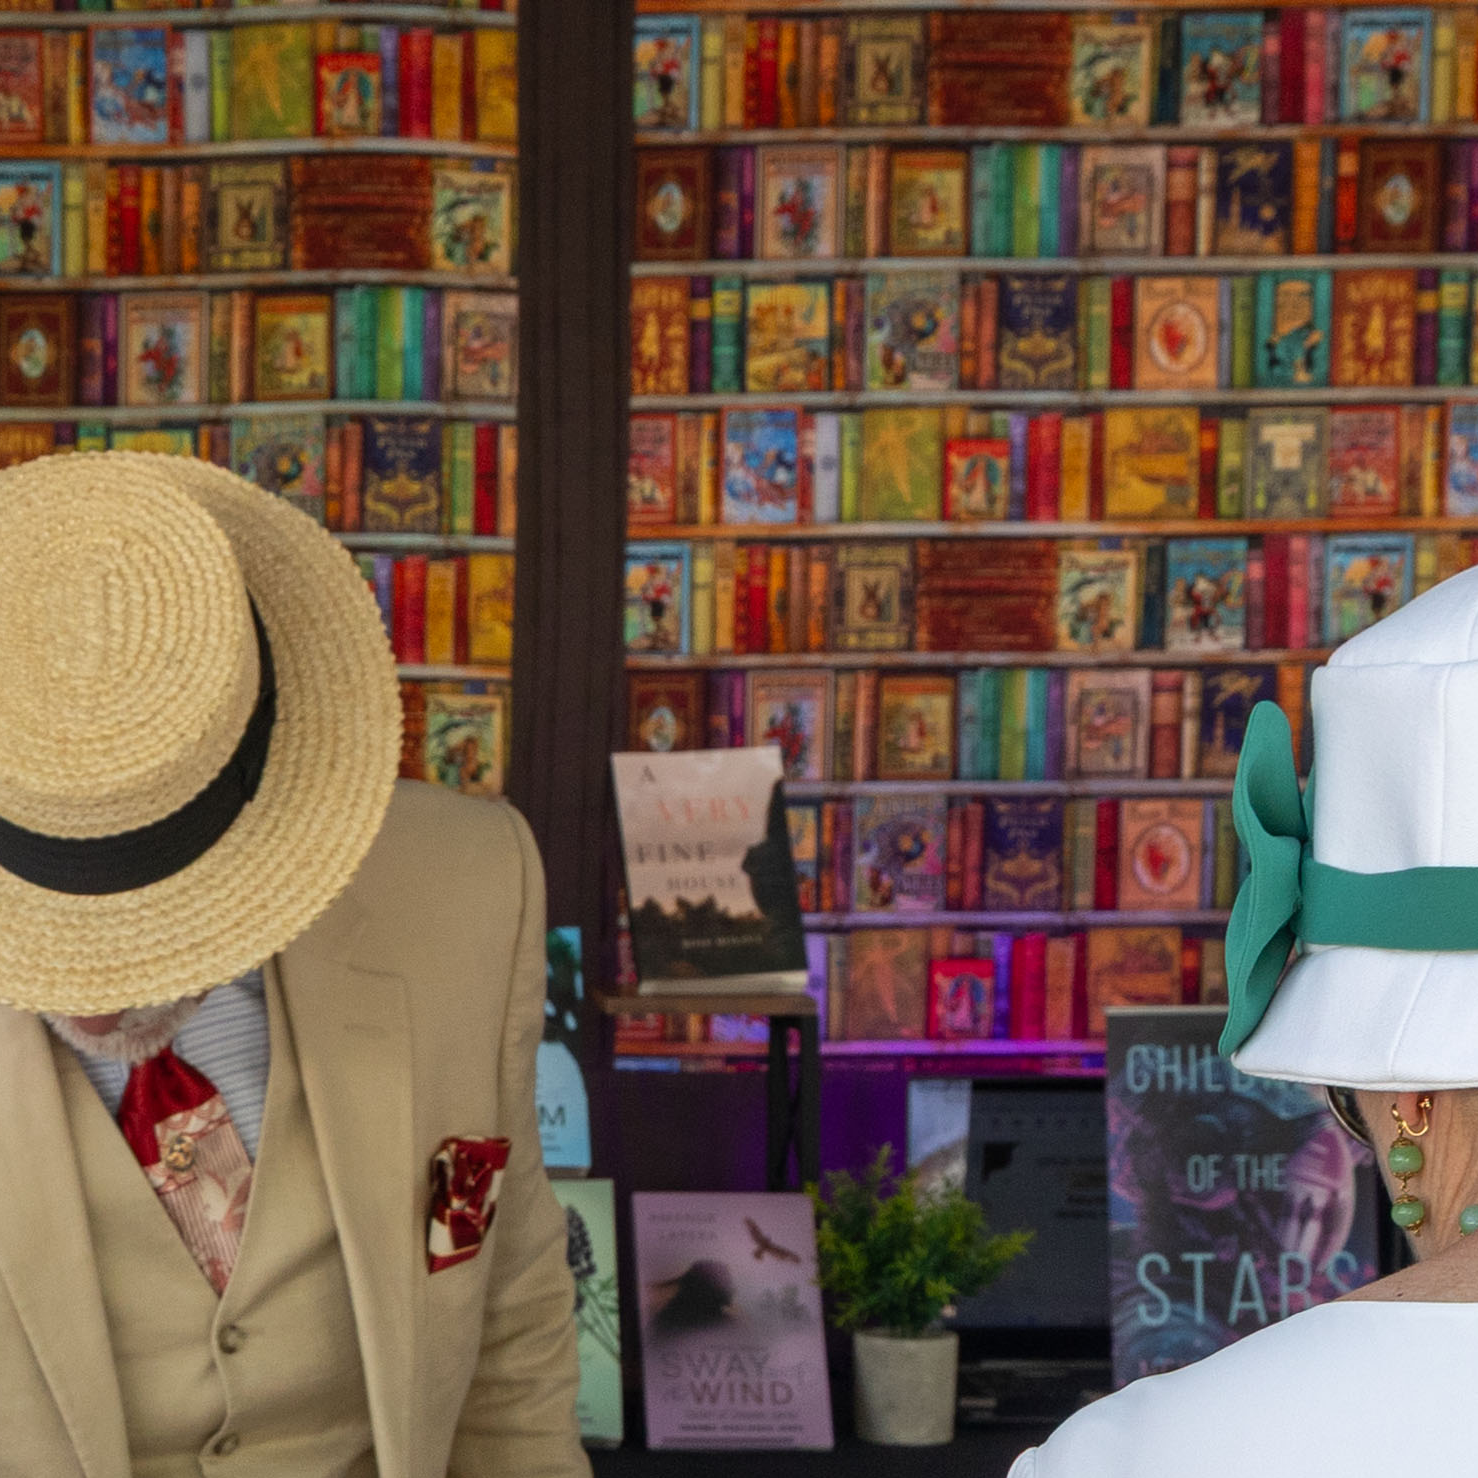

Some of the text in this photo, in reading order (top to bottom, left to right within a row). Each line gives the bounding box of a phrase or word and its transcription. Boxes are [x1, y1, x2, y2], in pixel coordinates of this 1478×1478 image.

[641, 765, 656, 783] A
[1186, 1152, 1288, 1193] OF THE
[659, 1351, 771, 1379] SWAY
[690, 1379, 795, 1407] WIND
